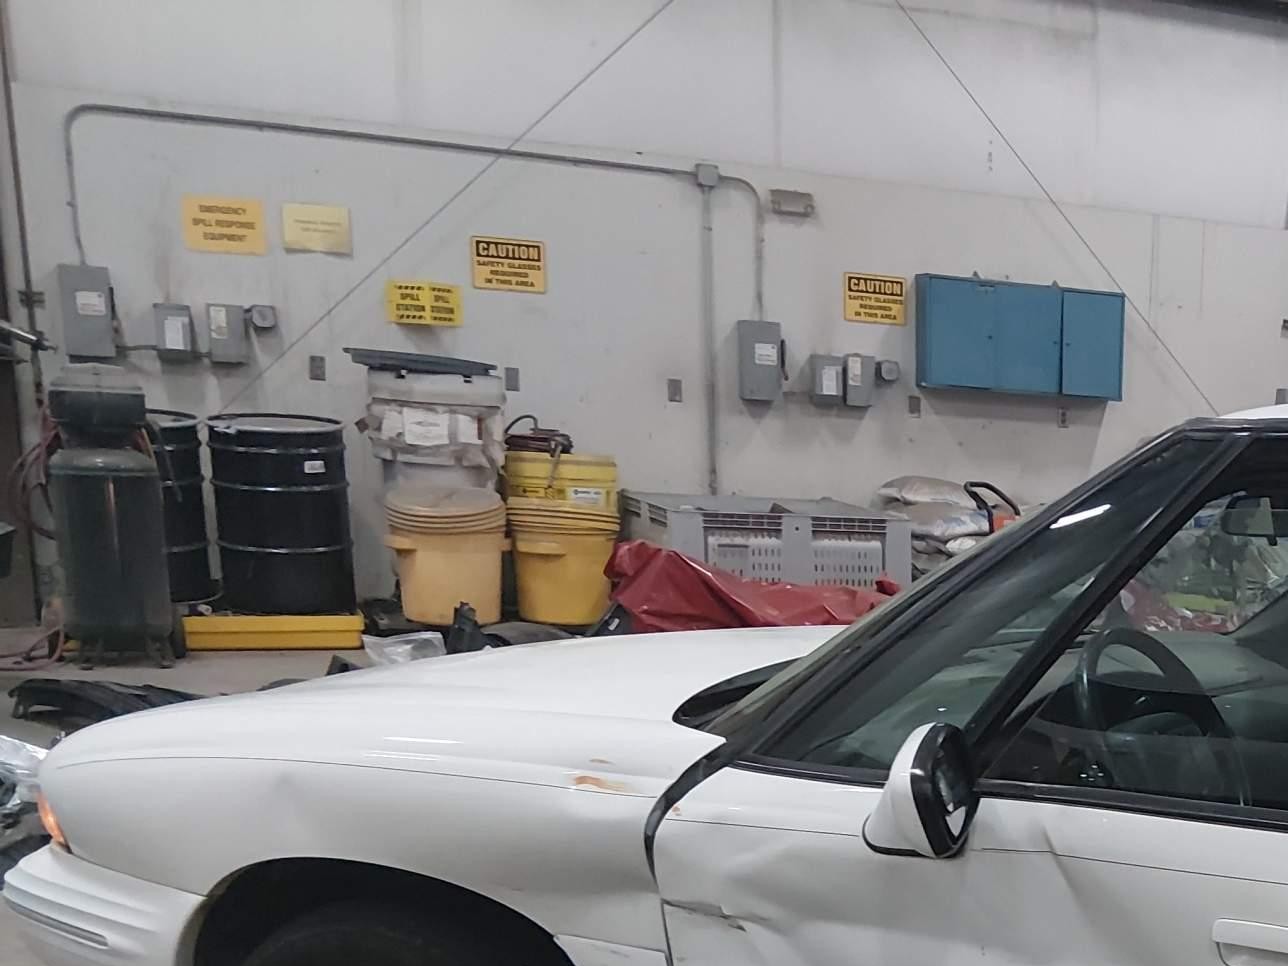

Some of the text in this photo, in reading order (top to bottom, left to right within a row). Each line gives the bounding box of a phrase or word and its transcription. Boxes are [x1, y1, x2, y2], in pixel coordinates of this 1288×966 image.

[192, 217, 256, 230] SPILL RESPONSE
[478, 242, 539, 260] CAUTION
[477, 260, 541, 271] SAFETY GLASSES
[515, 280, 535, 288] AREA
[850, 278, 901, 295] CAUTION
[400, 293, 420, 301] SPILL
[396, 304, 425, 312] STATION
